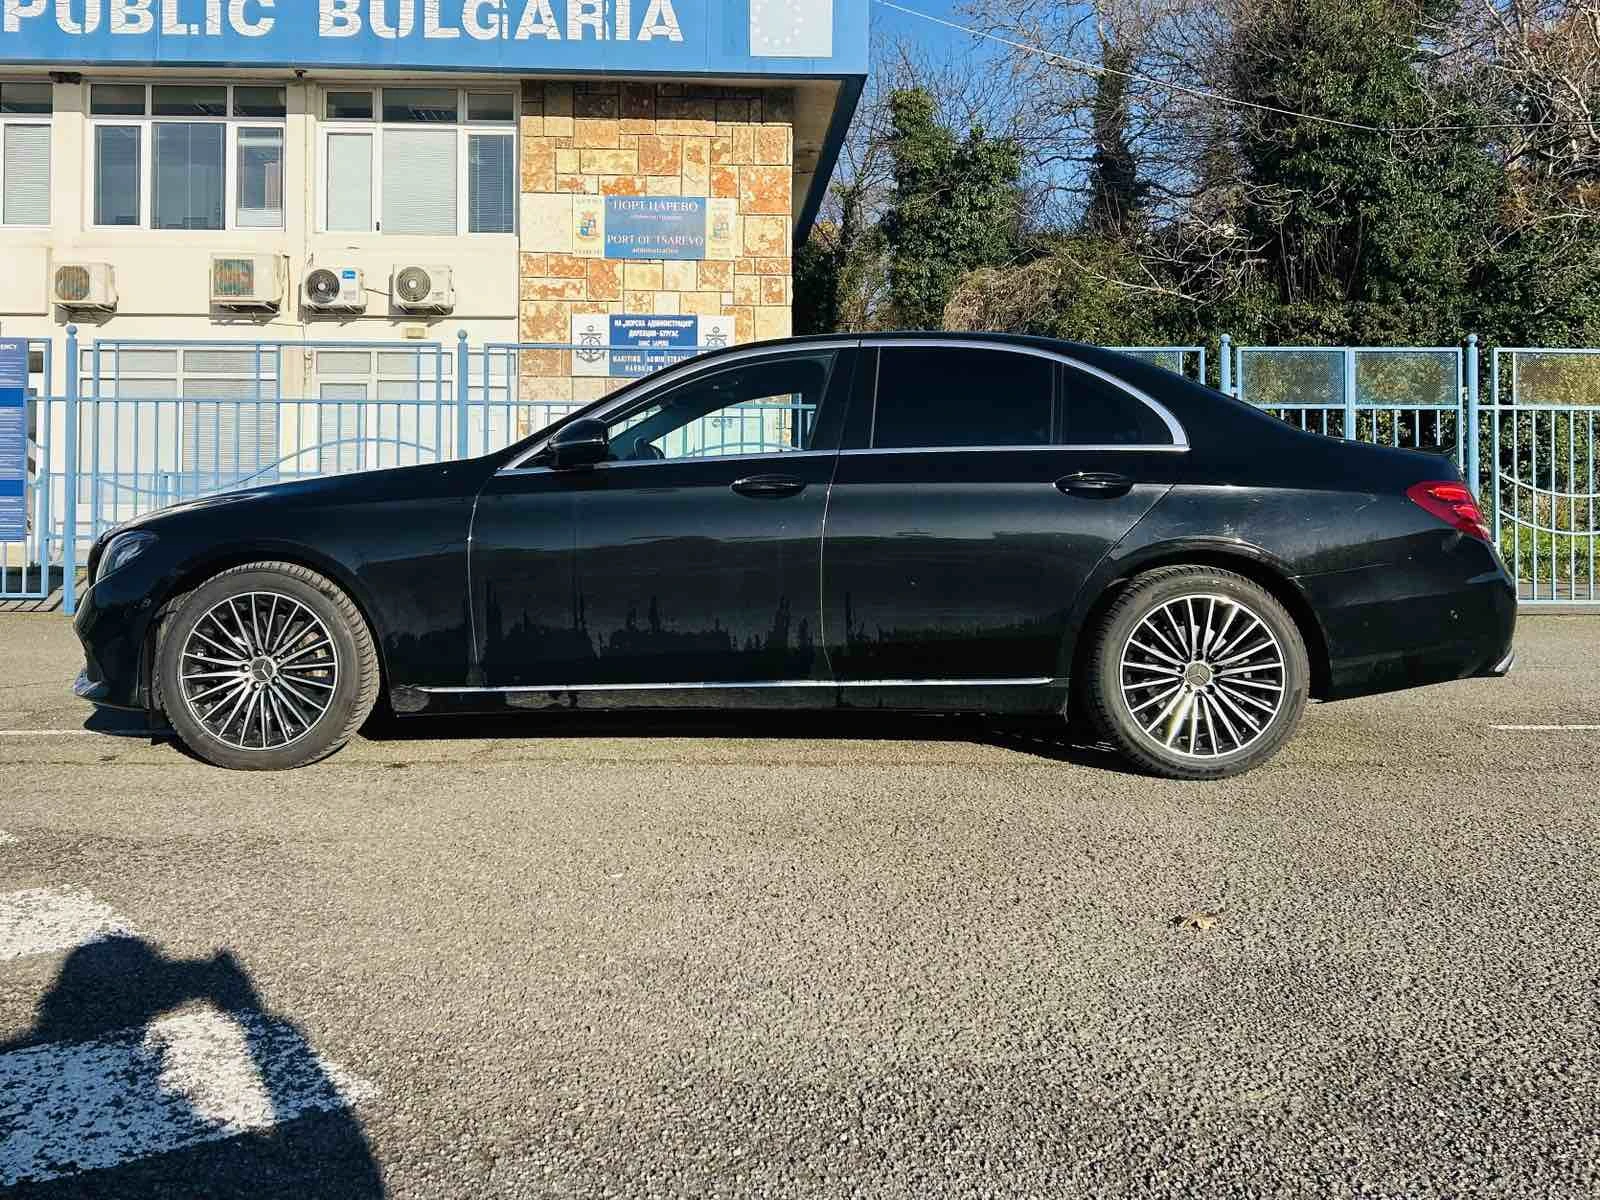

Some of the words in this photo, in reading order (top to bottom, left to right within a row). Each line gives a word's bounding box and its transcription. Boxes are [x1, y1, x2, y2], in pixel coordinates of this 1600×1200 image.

[4, 0, 275, 36] PUBLIC
[318, 0, 684, 41] BULGARIA
[607, 234, 634, 244] PORT
